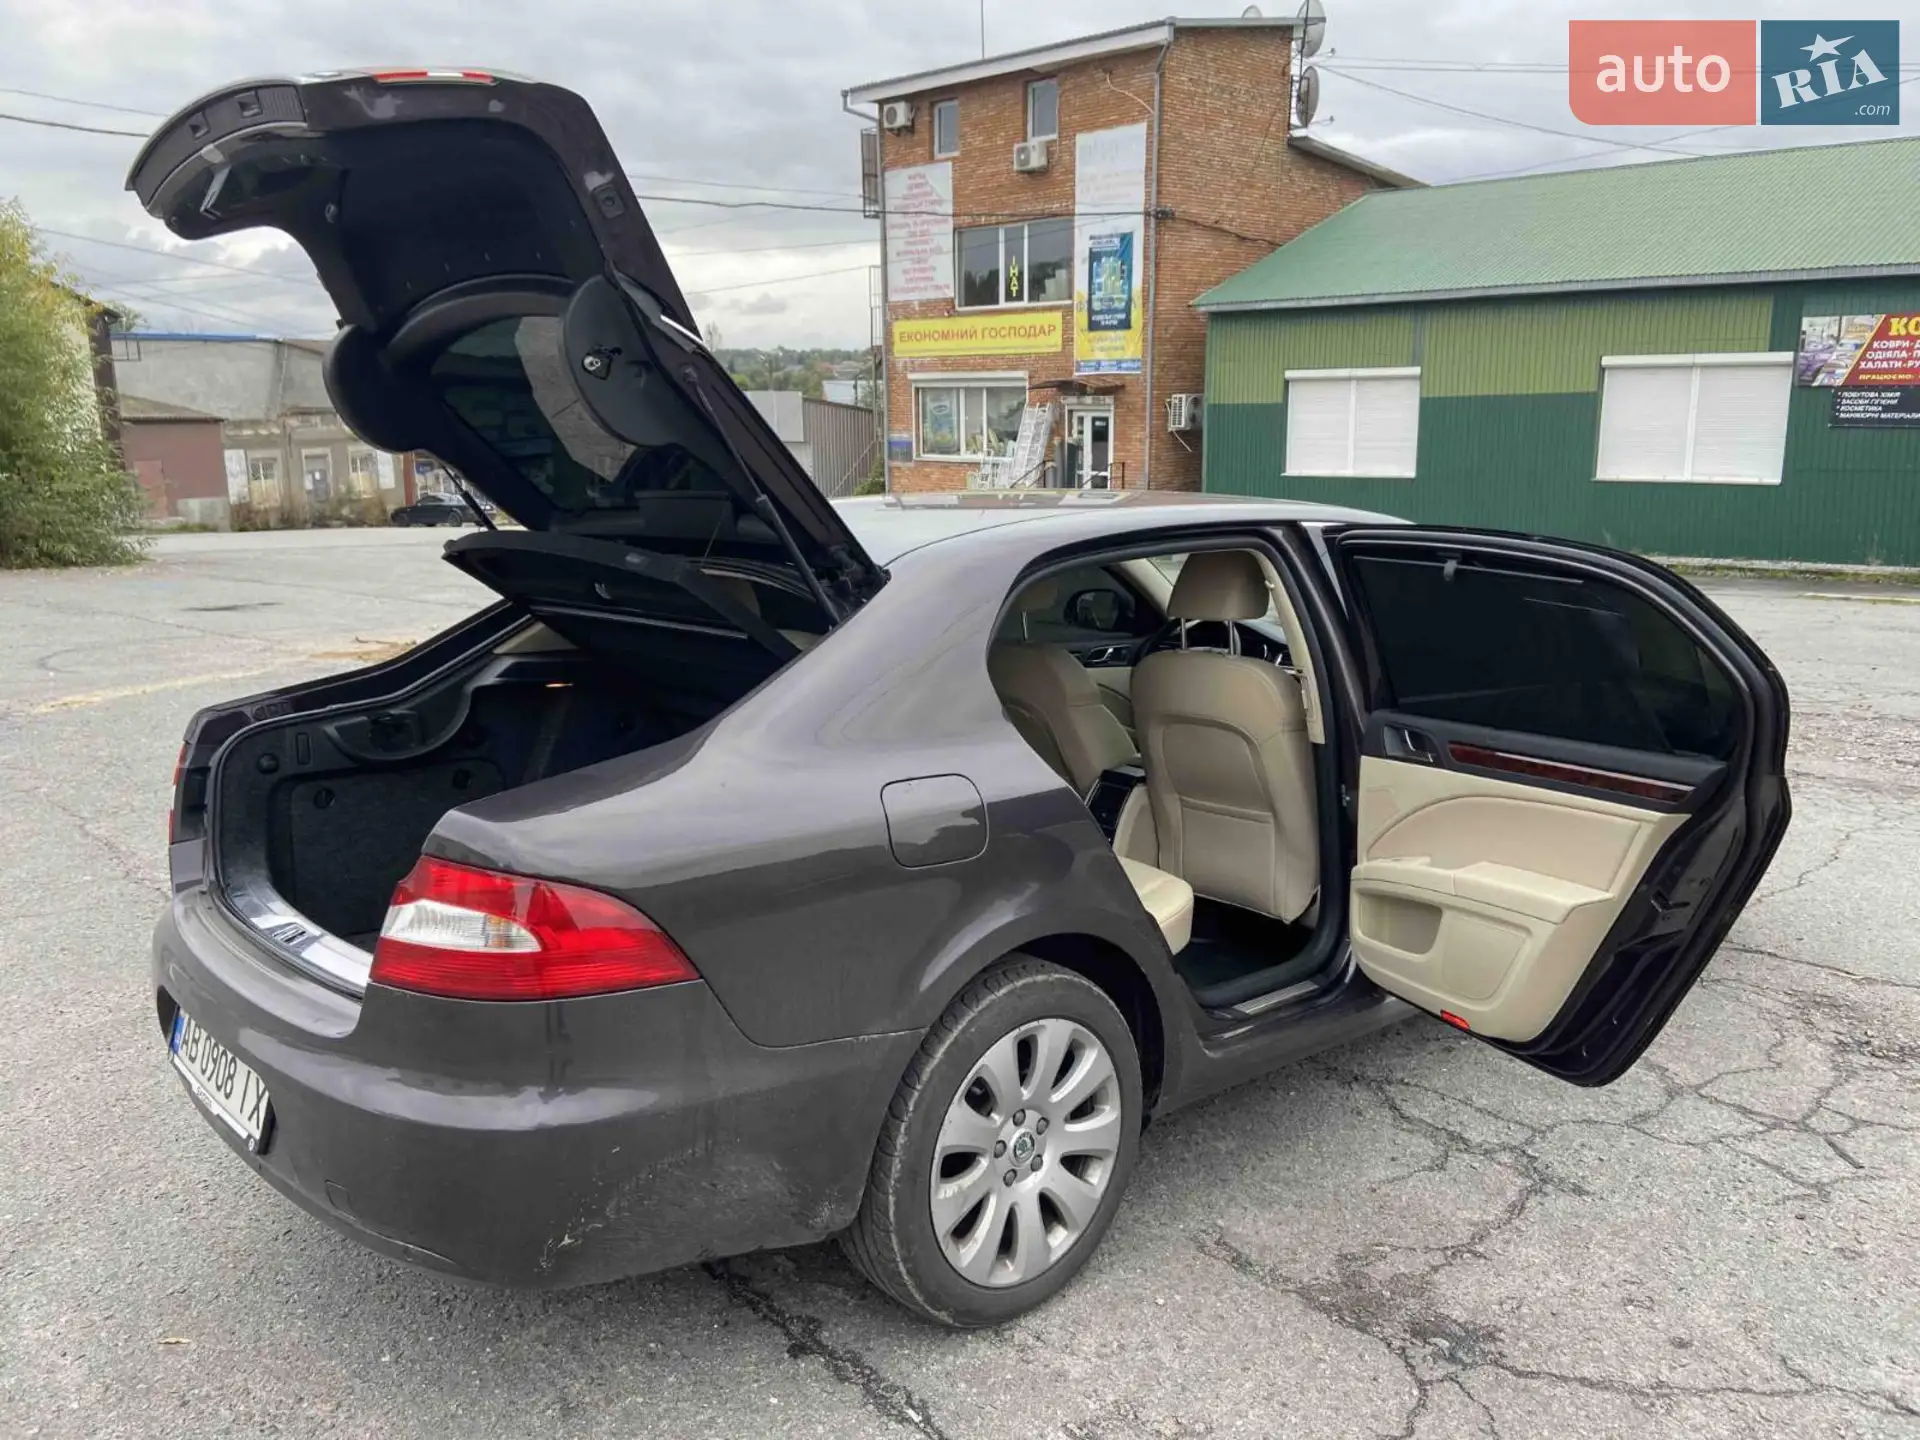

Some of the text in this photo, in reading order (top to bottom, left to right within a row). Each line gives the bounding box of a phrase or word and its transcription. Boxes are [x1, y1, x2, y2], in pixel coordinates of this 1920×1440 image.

[900, 324, 1057, 342] ЕКОНОМНИЙ ГОСПОДАР
[1873, 340, 1909, 349] КОВРИ
[1866, 350, 1908, 359] ОДІЯЛА
[1859, 360, 1902, 369] ХАЛАТИ
[181, 1016, 201, 1064] AB
[200, 1034, 237, 1100] 0908
[239, 1069, 268, 1130] IX
